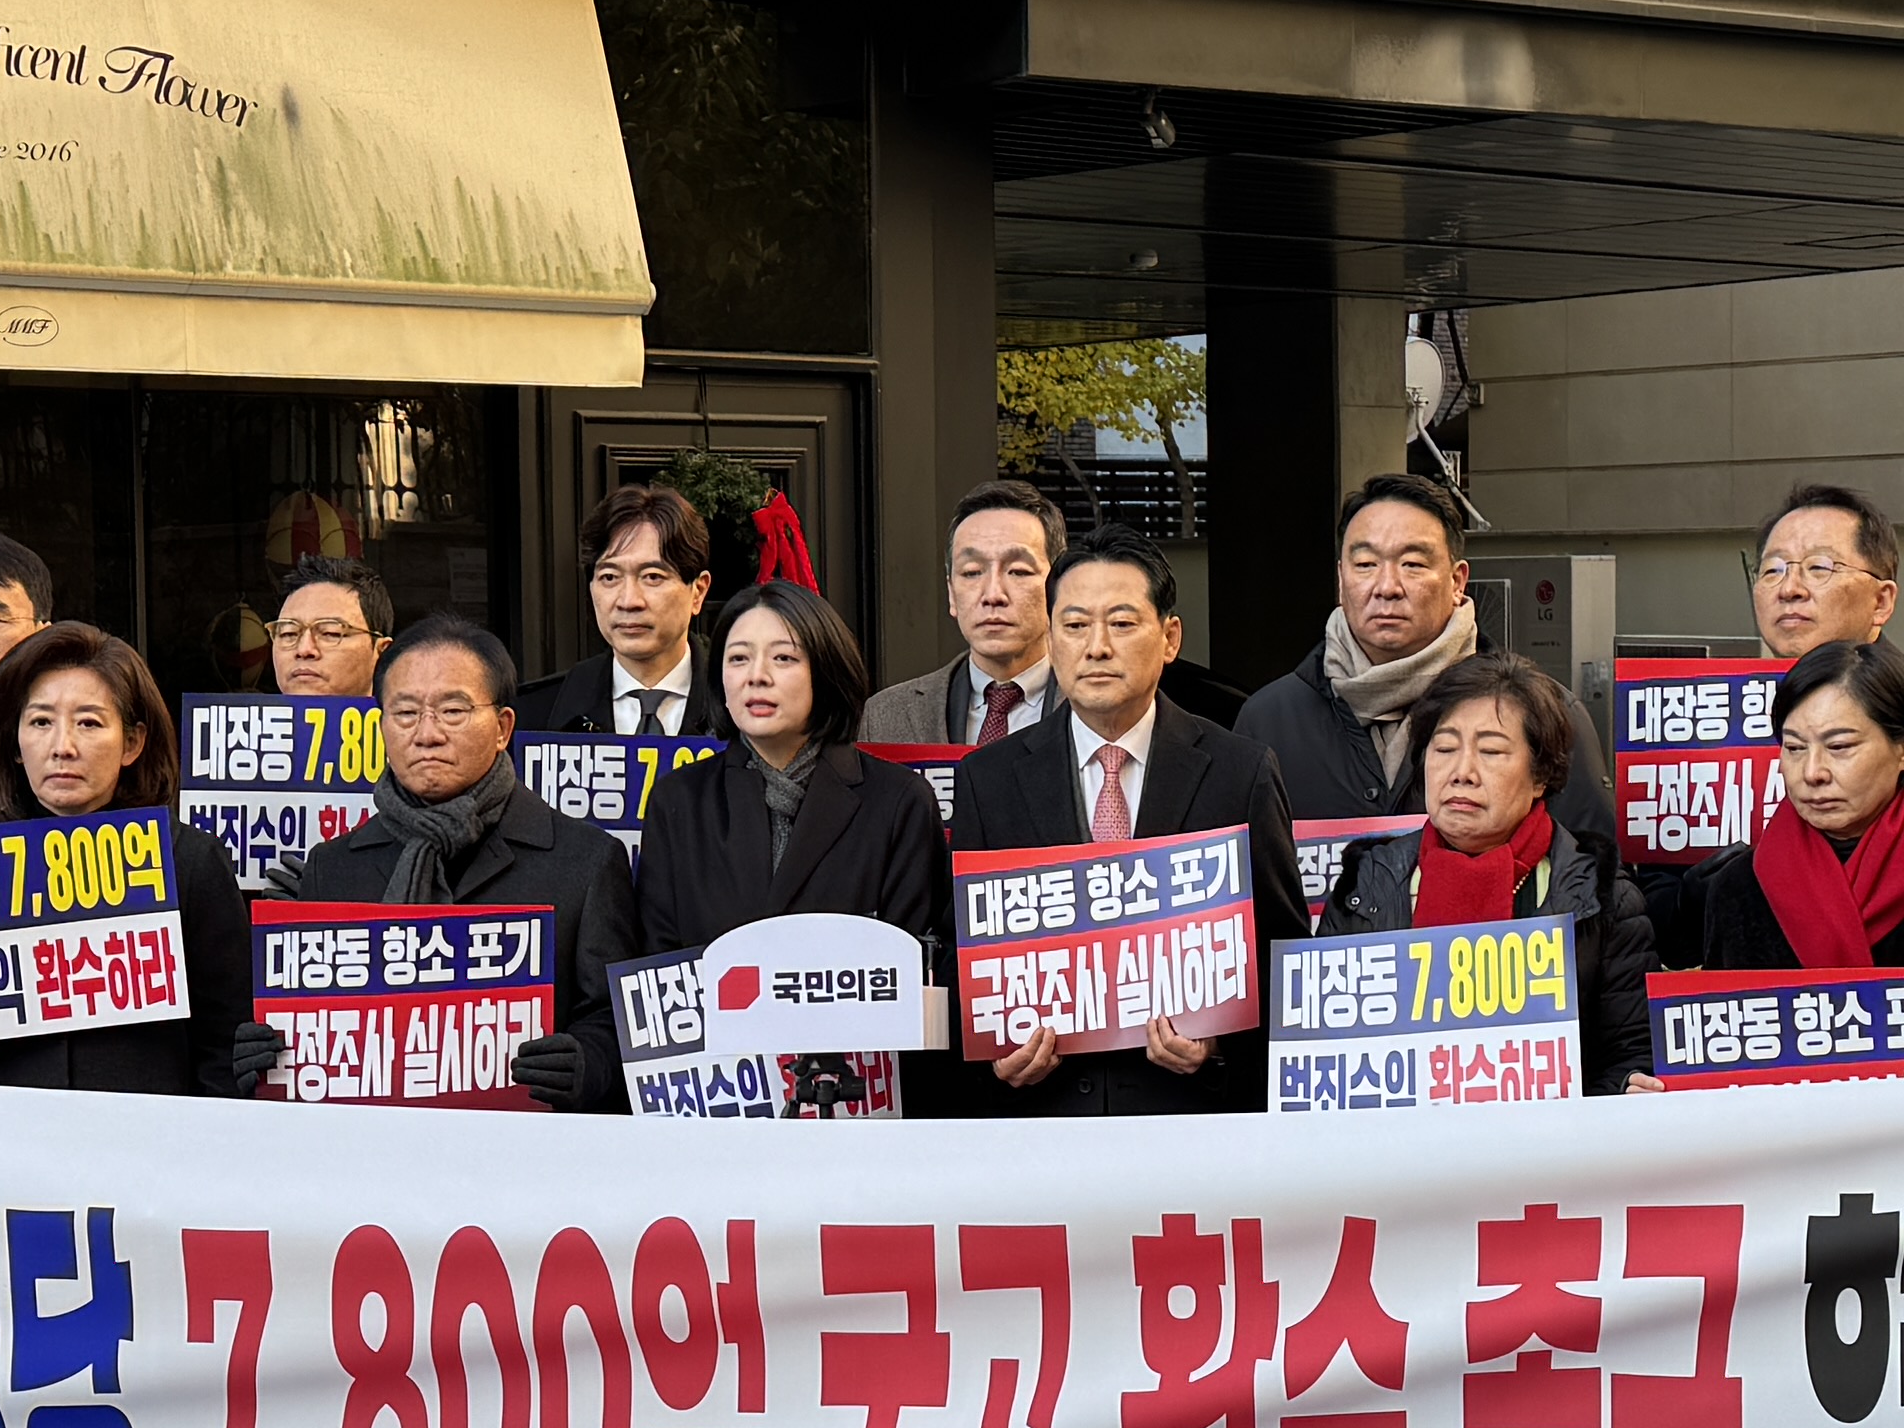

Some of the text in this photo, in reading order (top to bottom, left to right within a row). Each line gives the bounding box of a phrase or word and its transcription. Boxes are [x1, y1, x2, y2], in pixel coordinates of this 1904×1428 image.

[98, 44, 259, 128] Flower
[15, 139, 79, 163] 2016
[1538, 608, 1553, 621] LG
[192, 705, 386, 784] 대장동 7,80
[1628, 680, 1777, 743] 대장동 항
[524, 744, 626, 820] 대장동
[1627, 758, 1754, 852] 국정조사
[1, 819, 166, 918] 7,800억
[967, 869, 1076, 937] 대장동
[1087, 858, 1160, 922] 항소
[1170, 838, 1240, 907] 포기
[33, 927, 176, 1020] 환수하라
[265, 918, 541, 989] 대장동 항소 포기
[772, 967, 898, 1004] 국민의힘
[971, 912, 1248, 1047] 국정조사 실시하라
[1282, 927, 1566, 1030] 대장동 7,800억
[619, 959, 705, 1049] 대장
[1663, 996, 1782, 1066] 대장동
[1793, 990, 1875, 1058] 항소
[265, 1006, 395, 1102] 국정조사
